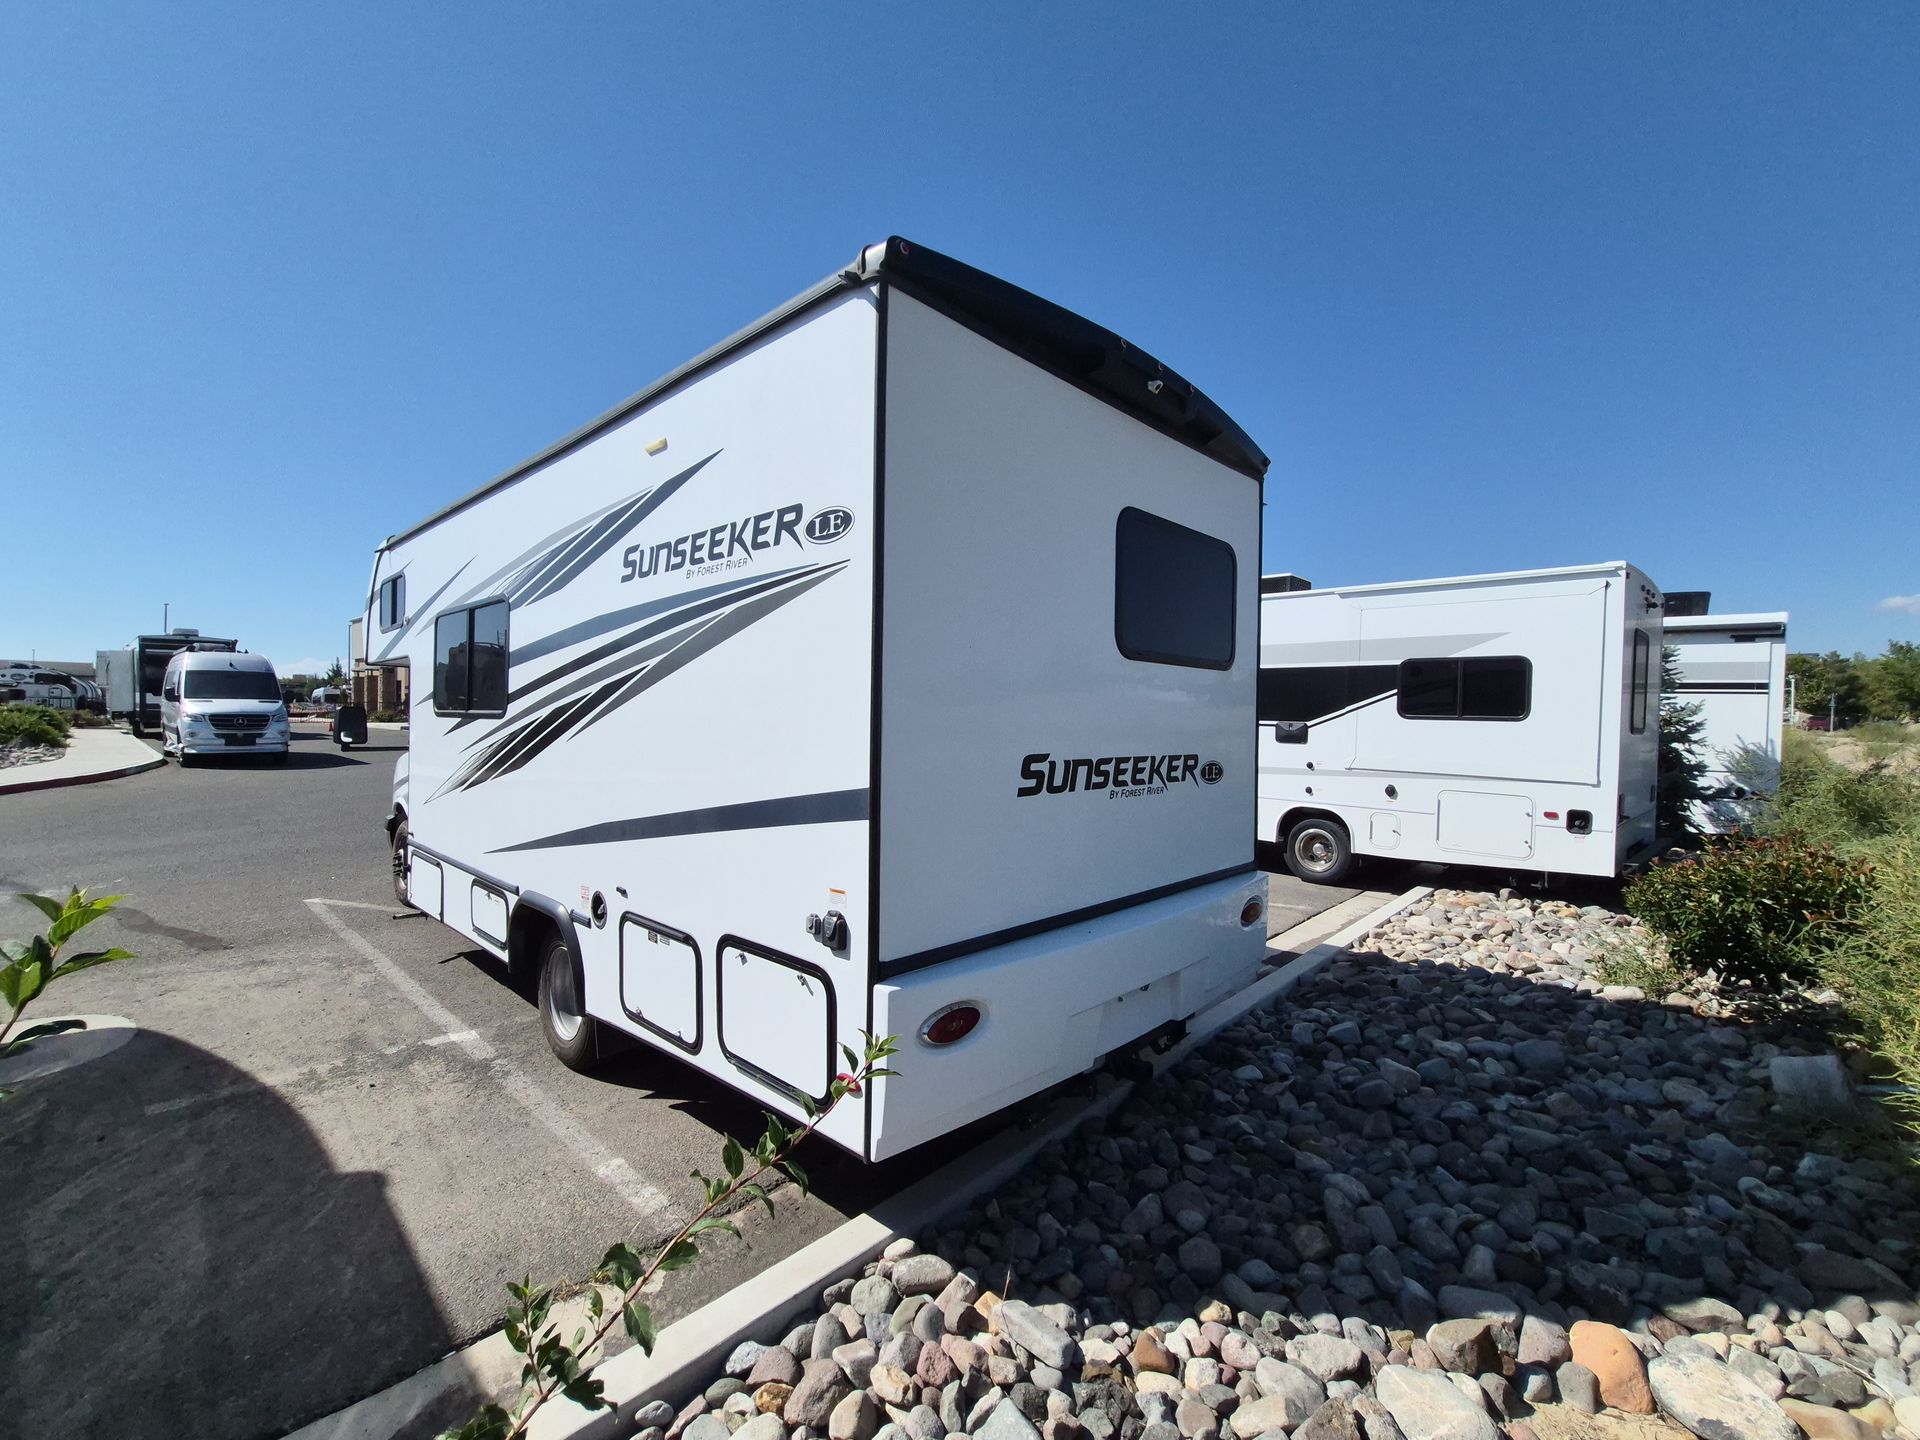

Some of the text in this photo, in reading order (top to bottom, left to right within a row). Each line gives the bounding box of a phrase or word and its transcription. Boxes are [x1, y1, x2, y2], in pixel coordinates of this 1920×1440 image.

[811, 509, 847, 540] LE
[697, 563, 724, 576] FOREST
[726, 558, 747, 570] RIVER
[1203, 764, 1222, 780] LE
[1121, 788, 1146, 798] FOREST
[1147, 786, 1165, 796] RIVER
